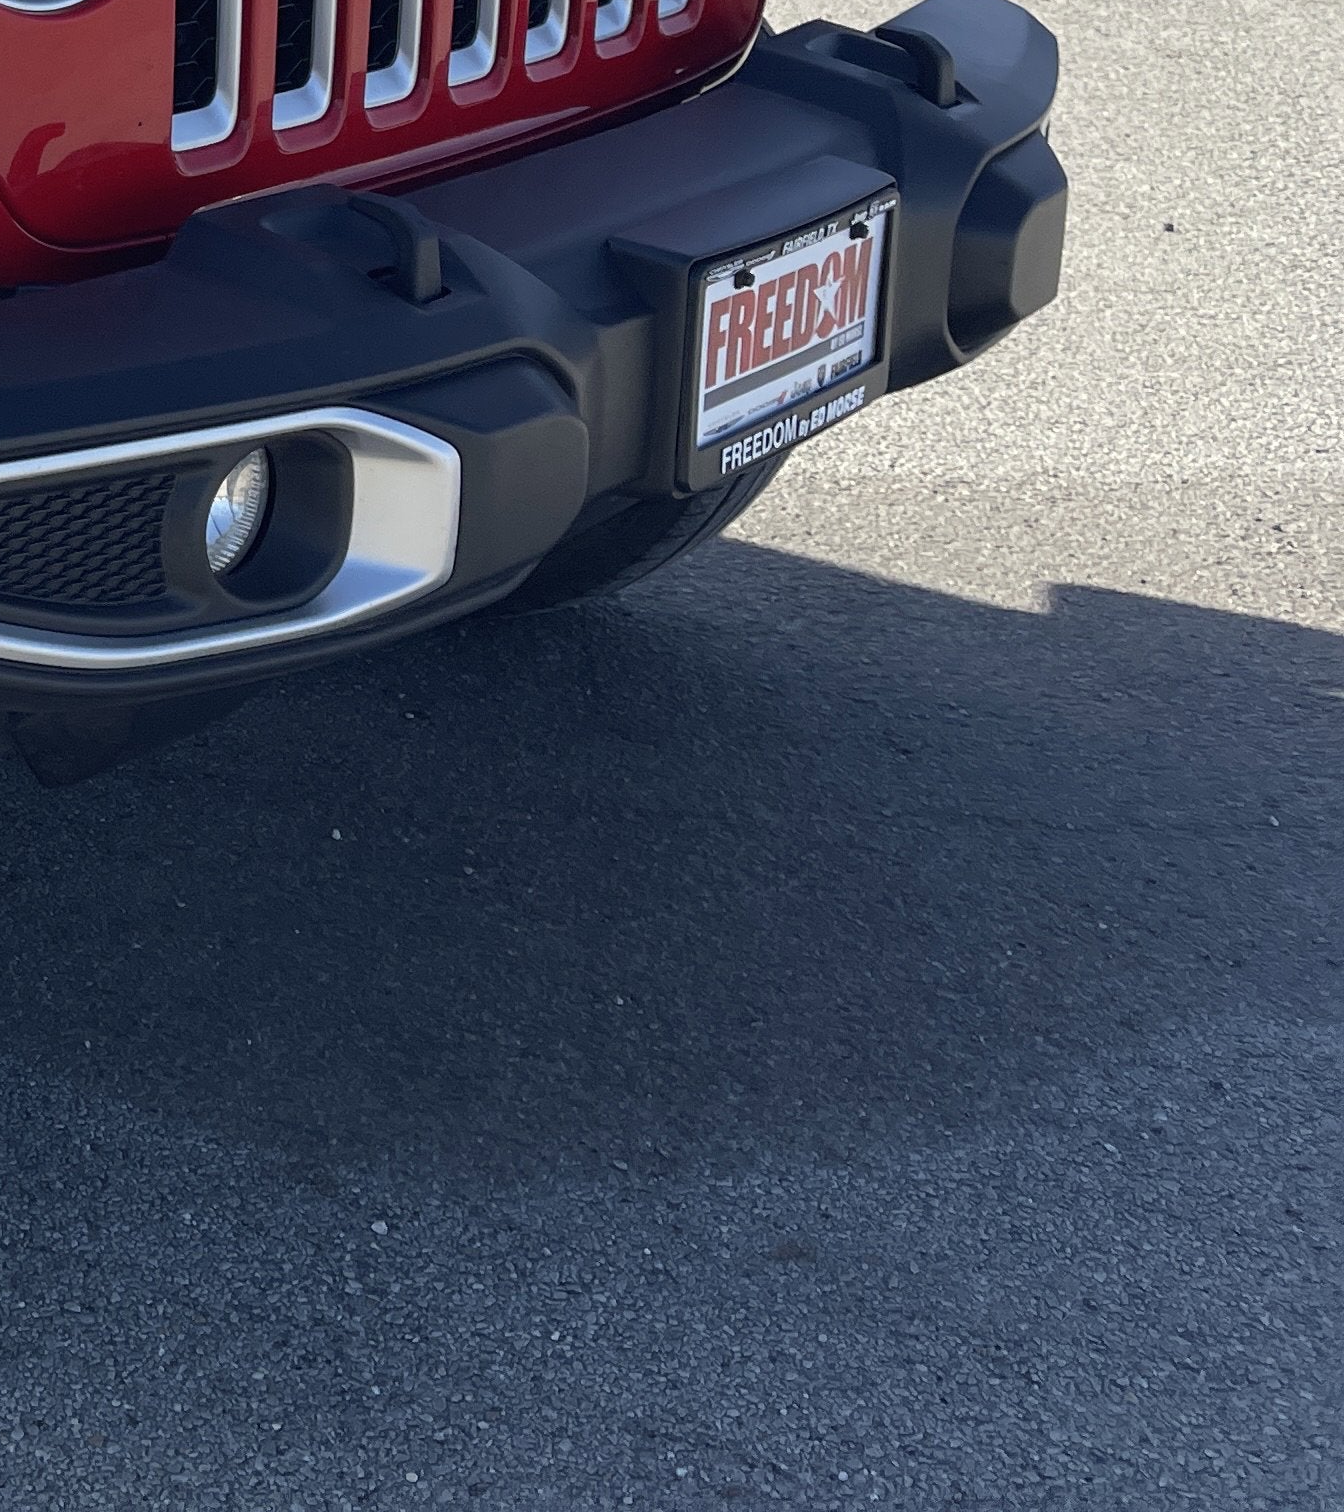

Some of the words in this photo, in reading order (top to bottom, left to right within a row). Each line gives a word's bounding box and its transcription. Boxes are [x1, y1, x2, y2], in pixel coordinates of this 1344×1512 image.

[705, 236, 874, 389] FREEDOM
[722, 414, 798, 475] FREEDOM
[810, 406, 826, 431] ED
[826, 385, 866, 423] MORSE
